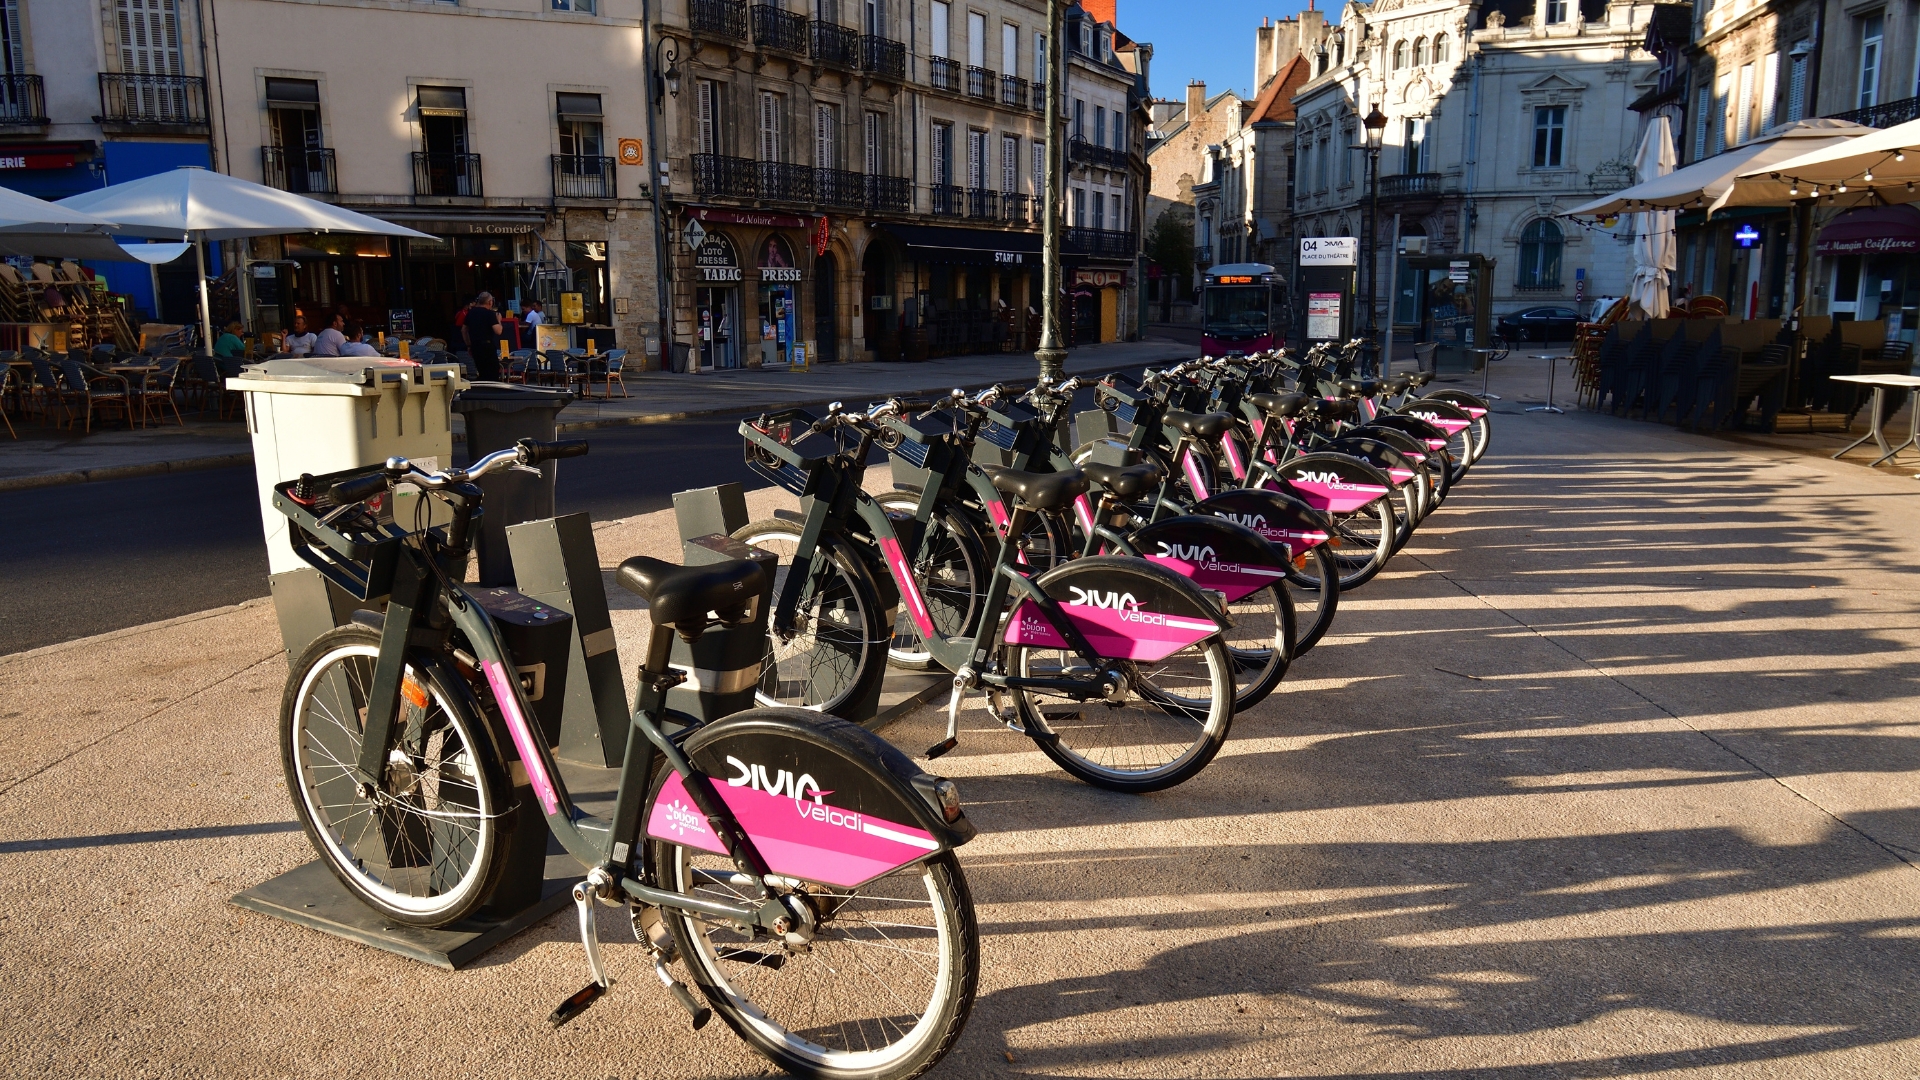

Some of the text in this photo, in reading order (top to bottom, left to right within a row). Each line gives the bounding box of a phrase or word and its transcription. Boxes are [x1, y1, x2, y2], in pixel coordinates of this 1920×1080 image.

[469, 224, 483, 234] La
[1303, 240, 1318, 252] 04
[1830, 241, 1862, 252] Mangin
[1864, 237, 1916, 251] Coiffure
[702, 247, 723, 256] LOTO
[994, 251, 1023, 264] START IN
[697, 256, 728, 265] PRESSE
[703, 268, 742, 281] TABAC
[762, 269, 802, 281] PRESSE
[1296, 469, 1342, 484] DIVIA
[1327, 482, 1357, 491] Velodi
[1155, 540, 1217, 562] DIVIA
[1198, 560, 1240, 573] Velodi
[489, 589, 509, 597] 14
[1068, 585, 1140, 613] DIVIA
[1117, 609, 1166, 627] Velodi
[725, 754, 827, 806] DIVIA
[794, 798, 865, 832] Velodi
